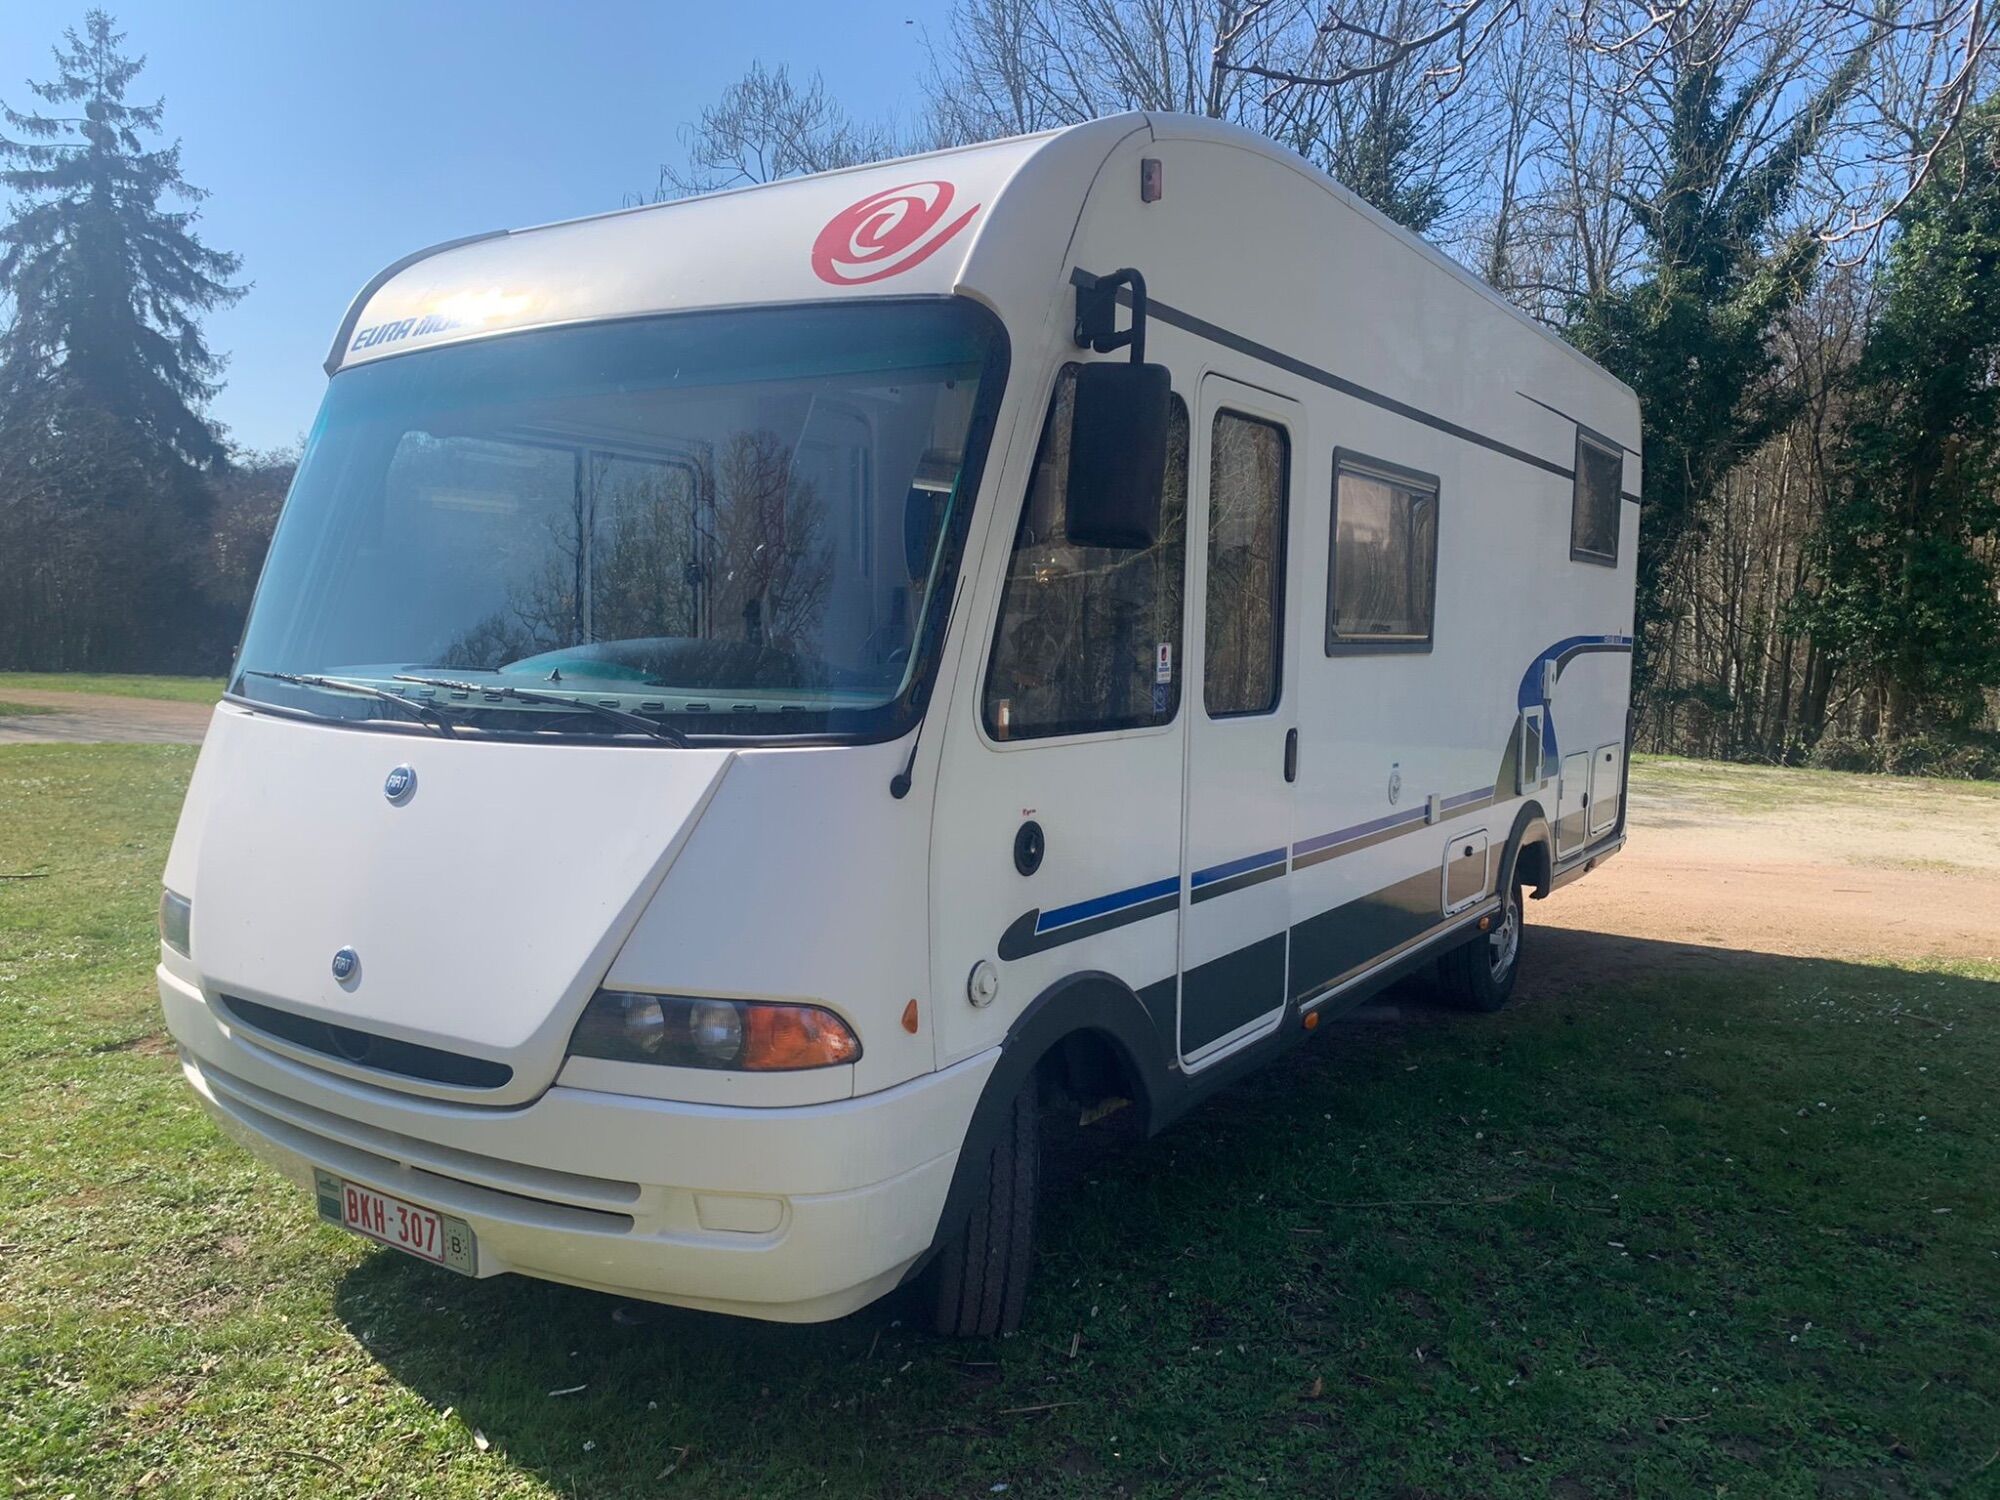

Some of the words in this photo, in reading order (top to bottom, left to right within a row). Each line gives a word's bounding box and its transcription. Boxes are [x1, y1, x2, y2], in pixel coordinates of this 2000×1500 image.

[351, 317, 416, 351] EURA
[387, 775, 408, 789] FIAT
[346, 1188, 436, 1252] BKH-307
[451, 1236, 462, 1254] B
